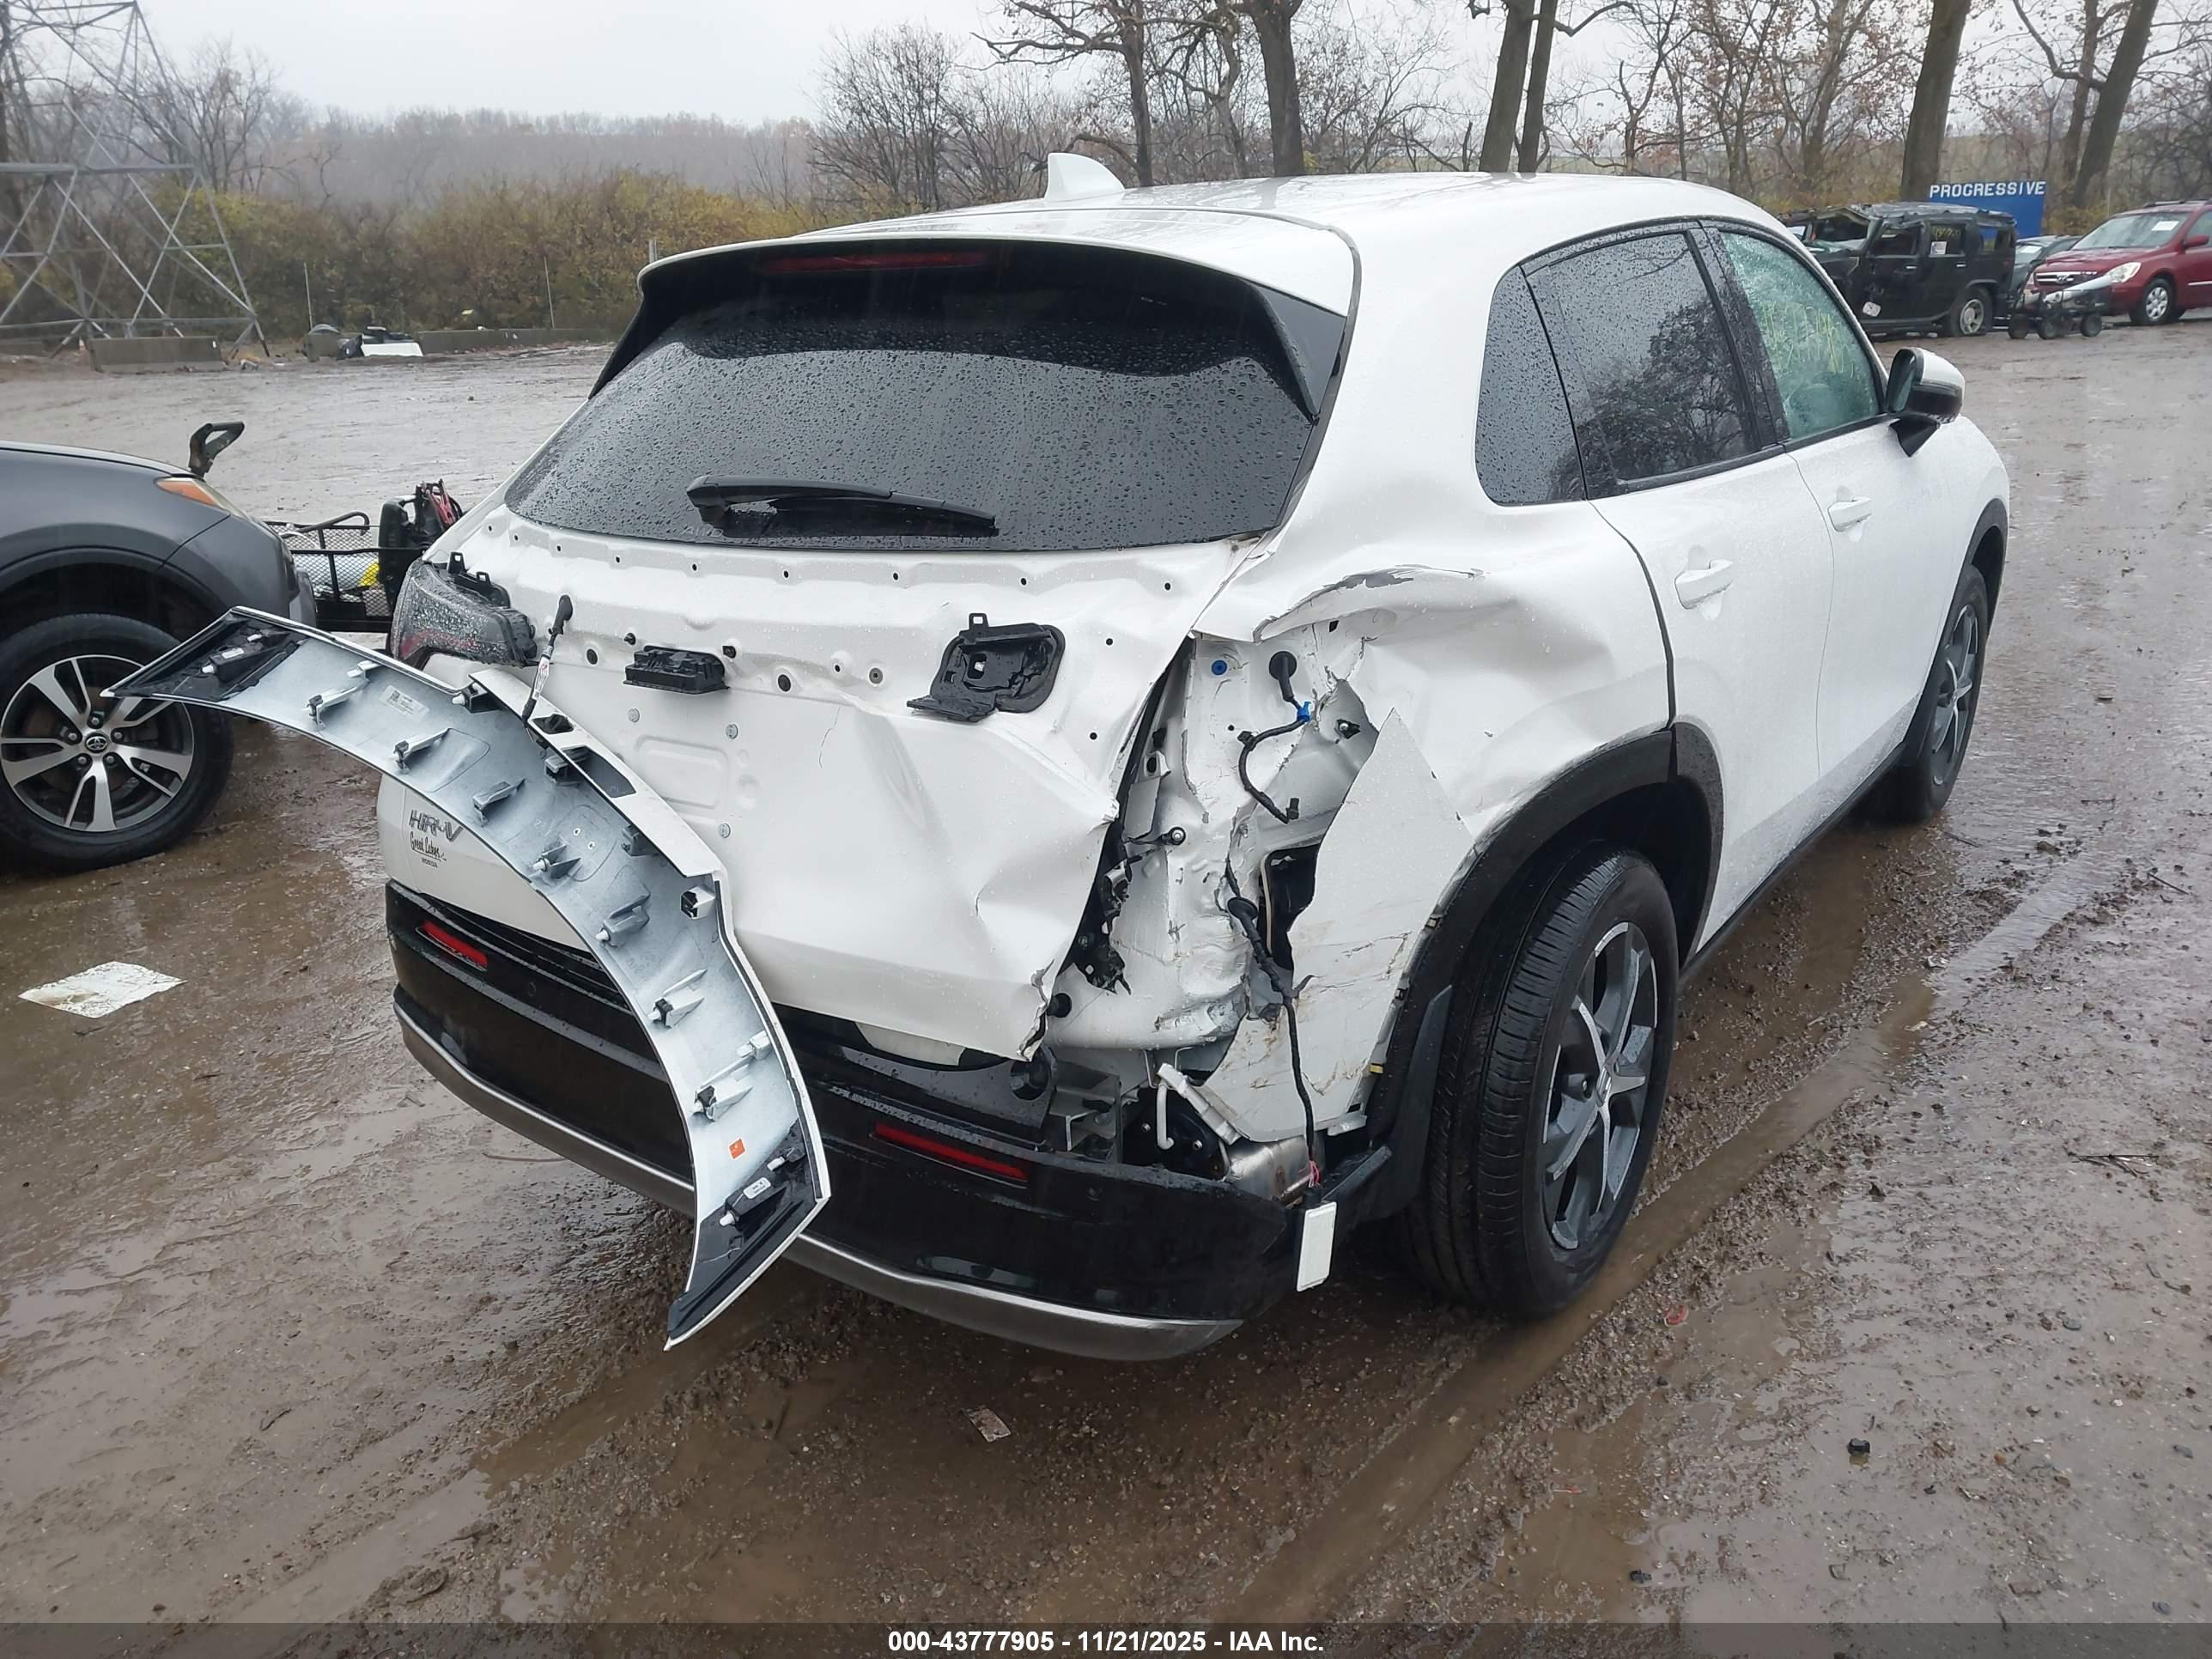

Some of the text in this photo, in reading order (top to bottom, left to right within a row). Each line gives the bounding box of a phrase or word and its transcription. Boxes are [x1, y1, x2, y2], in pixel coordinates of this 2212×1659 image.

[1929, 181, 2046, 198] PROGRESSIVE
[409, 810, 464, 842] HR-V
[410, 831, 441, 859] Great Lakes
